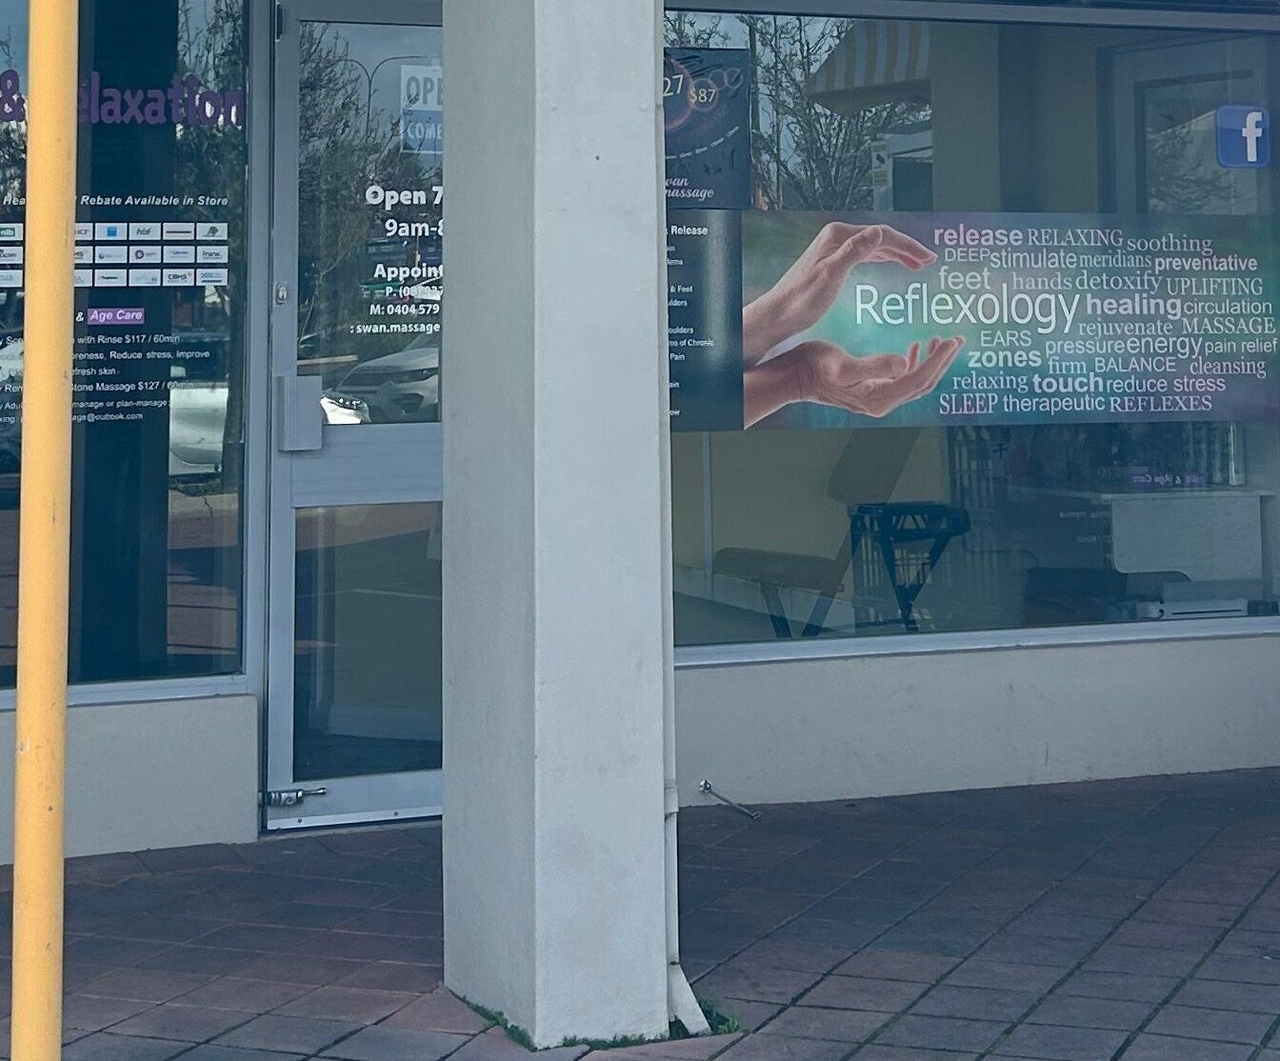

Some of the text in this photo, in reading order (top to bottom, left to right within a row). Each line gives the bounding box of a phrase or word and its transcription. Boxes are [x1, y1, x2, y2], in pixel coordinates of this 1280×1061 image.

[689, 89, 716, 103] $87
[81, 195, 228, 206] Rebate Available in Store
[365, 185, 443, 210] Open 7
[671, 226, 708, 236] Release
[934, 224, 1213, 255] release RELAXING soothing
[945, 248, 1258, 274] DEEP stimulate meridians preventative
[938, 266, 1263, 296] feet hands detoxify UPLIFTING
[76, 310, 143, 322] & Age Care
[370, 303, 440, 315] M: 0404 579
[855, 283, 1272, 334] Reflexology healing circulation
[356, 323, 440, 335] swan.massage
[1078, 317, 1276, 338] rejuvenate MASSAGE
[78, 334, 180, 344] with Rinse $117 60min
[981, 330, 1278, 359] EARS pressure energy pain relief
[109, 350, 143, 359] Reduce
[968, 350, 1266, 378] zones firm BALANCE cleansing
[96, 381, 159, 393] Massage $127
[953, 371, 1226, 393] relaxing touch reduce stress
[939, 393, 1212, 415] SLEEP therapeutic REFLEXES
